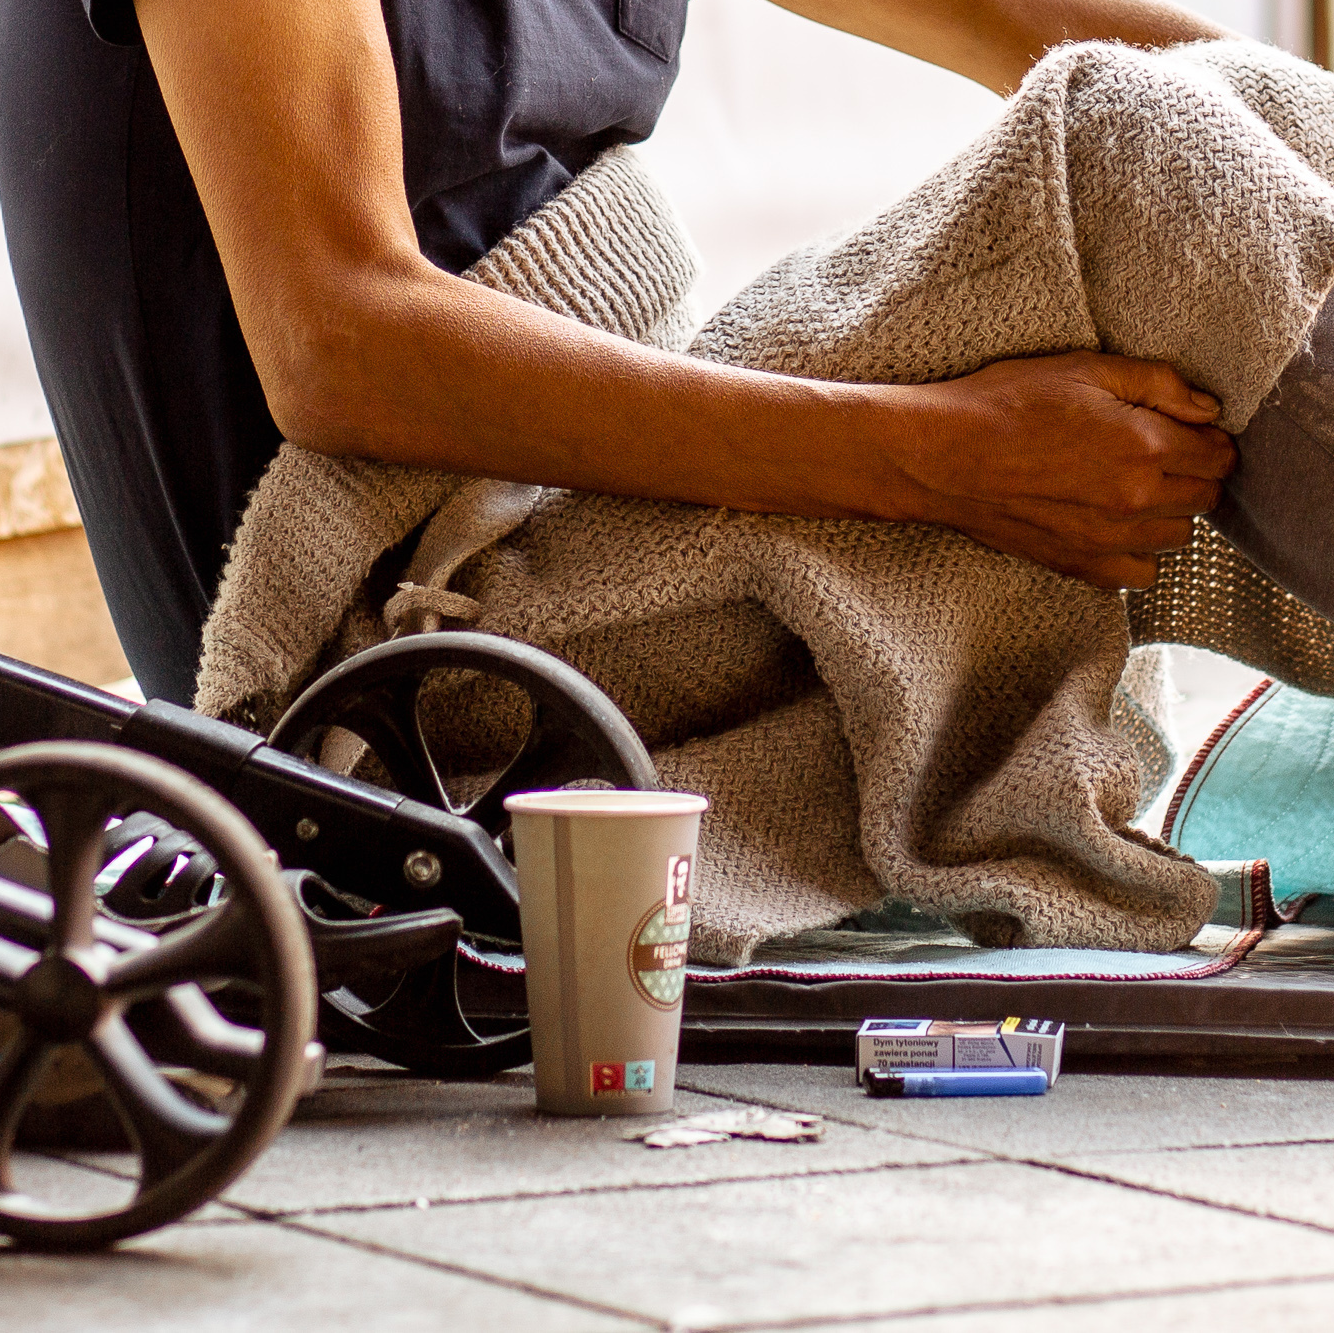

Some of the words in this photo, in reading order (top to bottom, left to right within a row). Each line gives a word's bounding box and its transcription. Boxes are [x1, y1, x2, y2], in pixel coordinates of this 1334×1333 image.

[873, 1038, 893, 1048] Dym
[895, 1038, 939, 1048] tytoniowy
[910, 1049, 938, 1058] ponad
[877, 1059, 888, 1067] 70
